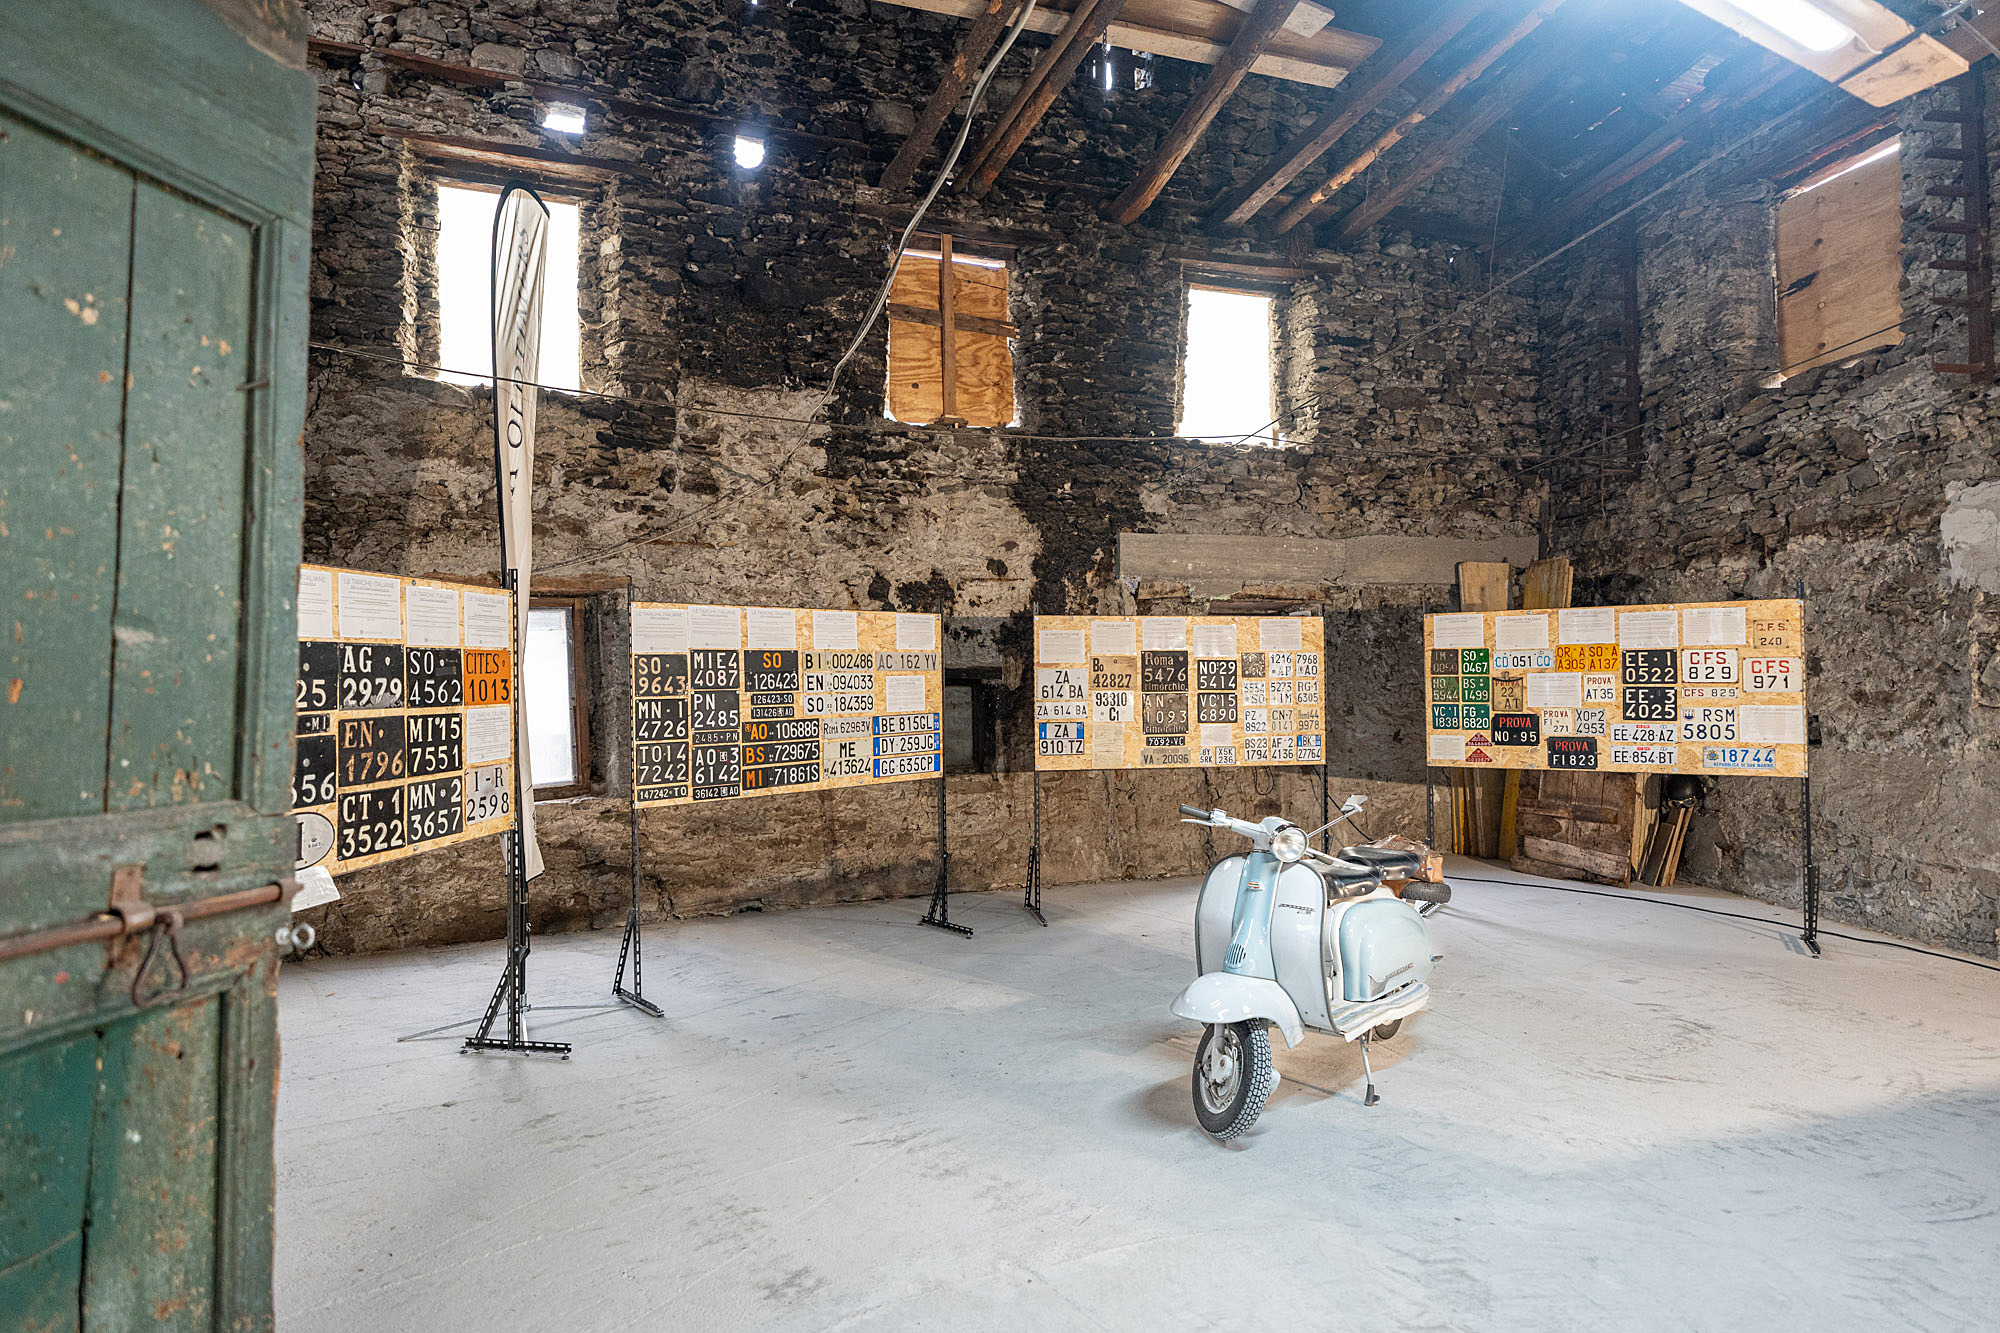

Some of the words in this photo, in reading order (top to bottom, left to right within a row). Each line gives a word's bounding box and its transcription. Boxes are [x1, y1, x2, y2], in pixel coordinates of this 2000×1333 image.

[1761, 637, 1782, 645] 240
[1464, 651, 1476, 661] SO
[1557, 647, 1570, 657] OR
[1589, 646, 1602, 657] SO
[343, 646, 372, 673] AG
[410, 651, 434, 674] SO
[466, 652, 500, 674] CITES
[763, 652, 781, 668] SO
[806, 654, 821, 669] BI
[832, 654, 873, 669] 002486
[878, 655, 892, 669] AC
[901, 655, 920, 668] 162
[925, 653, 937, 670] YV
[1145, 652, 1174, 665] Roma
[1297, 655, 1317, 664] 7968
[1496, 657, 1508, 667] CD
[1513, 656, 1531, 667] 051
[1537, 656, 1550, 667] CQ
[1558, 659, 1585, 670] A305
[1590, 658, 1617, 669] A137
[1626, 652, 1648, 666] EE
[639, 657, 661, 674] SO
[1305, 665, 1317, 675] AO
[1463, 663, 1487, 672] 0467
[694, 671, 738, 686] 4087
[1056, 671, 1069, 683] ZA
[1144, 668, 1186, 681] 5476
[1626, 668, 1674, 682] 0522
[1689, 667, 1731, 679] 829
[639, 676, 685, 694] 9643
[754, 673, 798, 689] 126423
[807, 675, 823, 690] EN
[833, 675, 873, 690] 094033
[1093, 674, 1131, 688] 42827
[1200, 676, 1236, 688] 5414
[1298, 682, 1310, 691] RG
[1464, 679, 1475, 688] BS
[1754, 675, 1788, 688] 971
[343, 678, 402, 706] 2979
[410, 679, 461, 704] 4562
[469, 679, 509, 702] 1013
[1042, 685, 1063, 698] 614
[1069, 685, 1083, 698] BA
[1434, 690, 1458, 700] 5944
[1465, 690, 1488, 700] 1499
[1502, 687, 1514, 697] 22
[1626, 689, 1648, 703] EE
[1712, 689, 1735, 697] 829
[694, 694, 715, 711] PN
[807, 697, 824, 712] SO
[835, 696, 873, 712] 184359
[1096, 692, 1127, 706] 93310
[1145, 695, 1163, 707] AN
[1298, 693, 1318, 702] 6305
[1505, 699, 1520, 709] AT
[639, 702, 661, 719] MN
[753, 709, 776, 717] 131426
[1037, 706, 1048, 715] ZA
[1054, 705, 1070, 715] 614
[1076, 705, 1087, 715] BA
[1201, 709, 1236, 721] 6890
[1245, 711, 1256, 720] PZ
[1272, 710, 1284, 720] CN
[1434, 707, 1445, 716] VC
[1464, 707, 1476, 717] FG
[1626, 704, 1675, 718] 4025
[1703, 709, 1735, 722] RSM
[694, 711, 738, 728] 2485
[1146, 711, 1186, 723] 1093
[1436, 717, 1458, 727] 1838
[1464, 718, 1488, 728] 6820
[1499, 718, 1531, 727] PROVA
[639, 720, 686, 738] 4726
[751, 724, 767, 739] AO
[776, 721, 818, 739] 106886
[841, 721, 870, 733] 62963V
[882, 718, 895, 732] BE
[1055, 725, 1069, 737] ZA
[1272, 721, 1292, 731] 0141
[1299, 720, 1319, 730] 9978
[1576, 723, 1605, 733] 4953
[343, 720, 373, 749] EN
[1495, 731, 1508, 741] NO
[1521, 731, 1536, 742] 95
[1683, 724, 1735, 740] 5805
[882, 738, 894, 753] DY
[1041, 741, 1063, 753] 910
[1068, 740, 1082, 753] TZ
[1272, 738, 1282, 748] AF
[1555, 741, 1588, 751] PROVA
[746, 747, 765, 764] BS
[774, 742, 818, 761] 729675
[840, 742, 855, 758] ME
[1246, 749, 1267, 760] 1794
[1272, 749, 1293, 759] 4136
[1298, 749, 1320, 758] 27764
[1722, 749, 1773, 763] 18744
[411, 745, 459, 772] 7551
[696, 749, 716, 766] AO
[1144, 755, 1154, 764] VA
[1163, 754, 1188, 763] 20096
[346, 749, 403, 782] 1796
[830, 758, 871, 775] 413624
[882, 760, 894, 774] GG
[900, 757, 932, 772] 635CP
[639, 763, 686, 783] 7242
[696, 765, 739, 784] 6142
[746, 770, 762, 787] MI
[409, 782, 436, 811] MN
[451, 778, 461, 802] 2
[695, 788, 719, 798] 36142
[729, 786, 739, 795] AO
[343, 793, 371, 822] CT
[392, 789, 399, 815] 1
[467, 792, 509, 822] 2598
[411, 807, 461, 840] 3657
[343, 820, 402, 856] 3522
